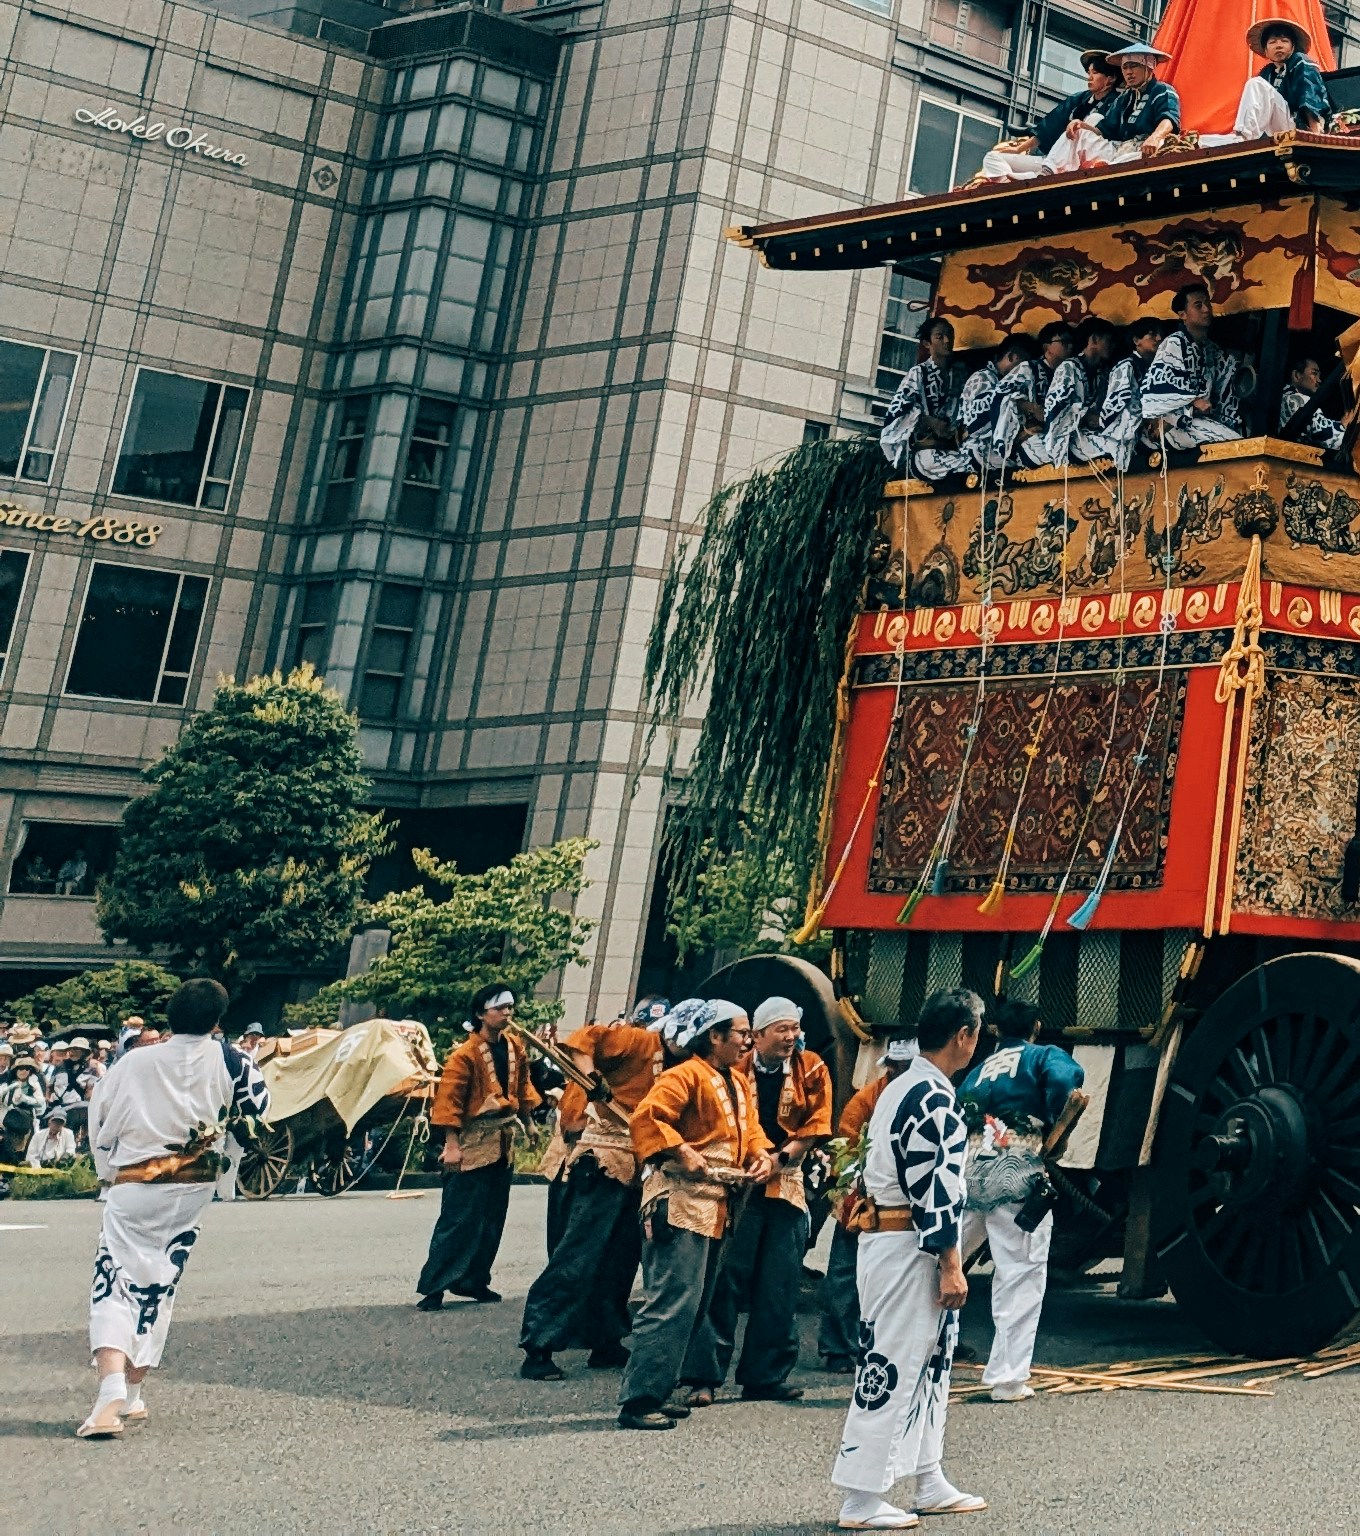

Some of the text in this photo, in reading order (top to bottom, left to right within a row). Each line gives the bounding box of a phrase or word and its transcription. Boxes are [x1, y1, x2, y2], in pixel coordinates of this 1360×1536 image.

[75, 107, 248, 167] Hotel Okura
[76, 515, 164, 546] 1888
